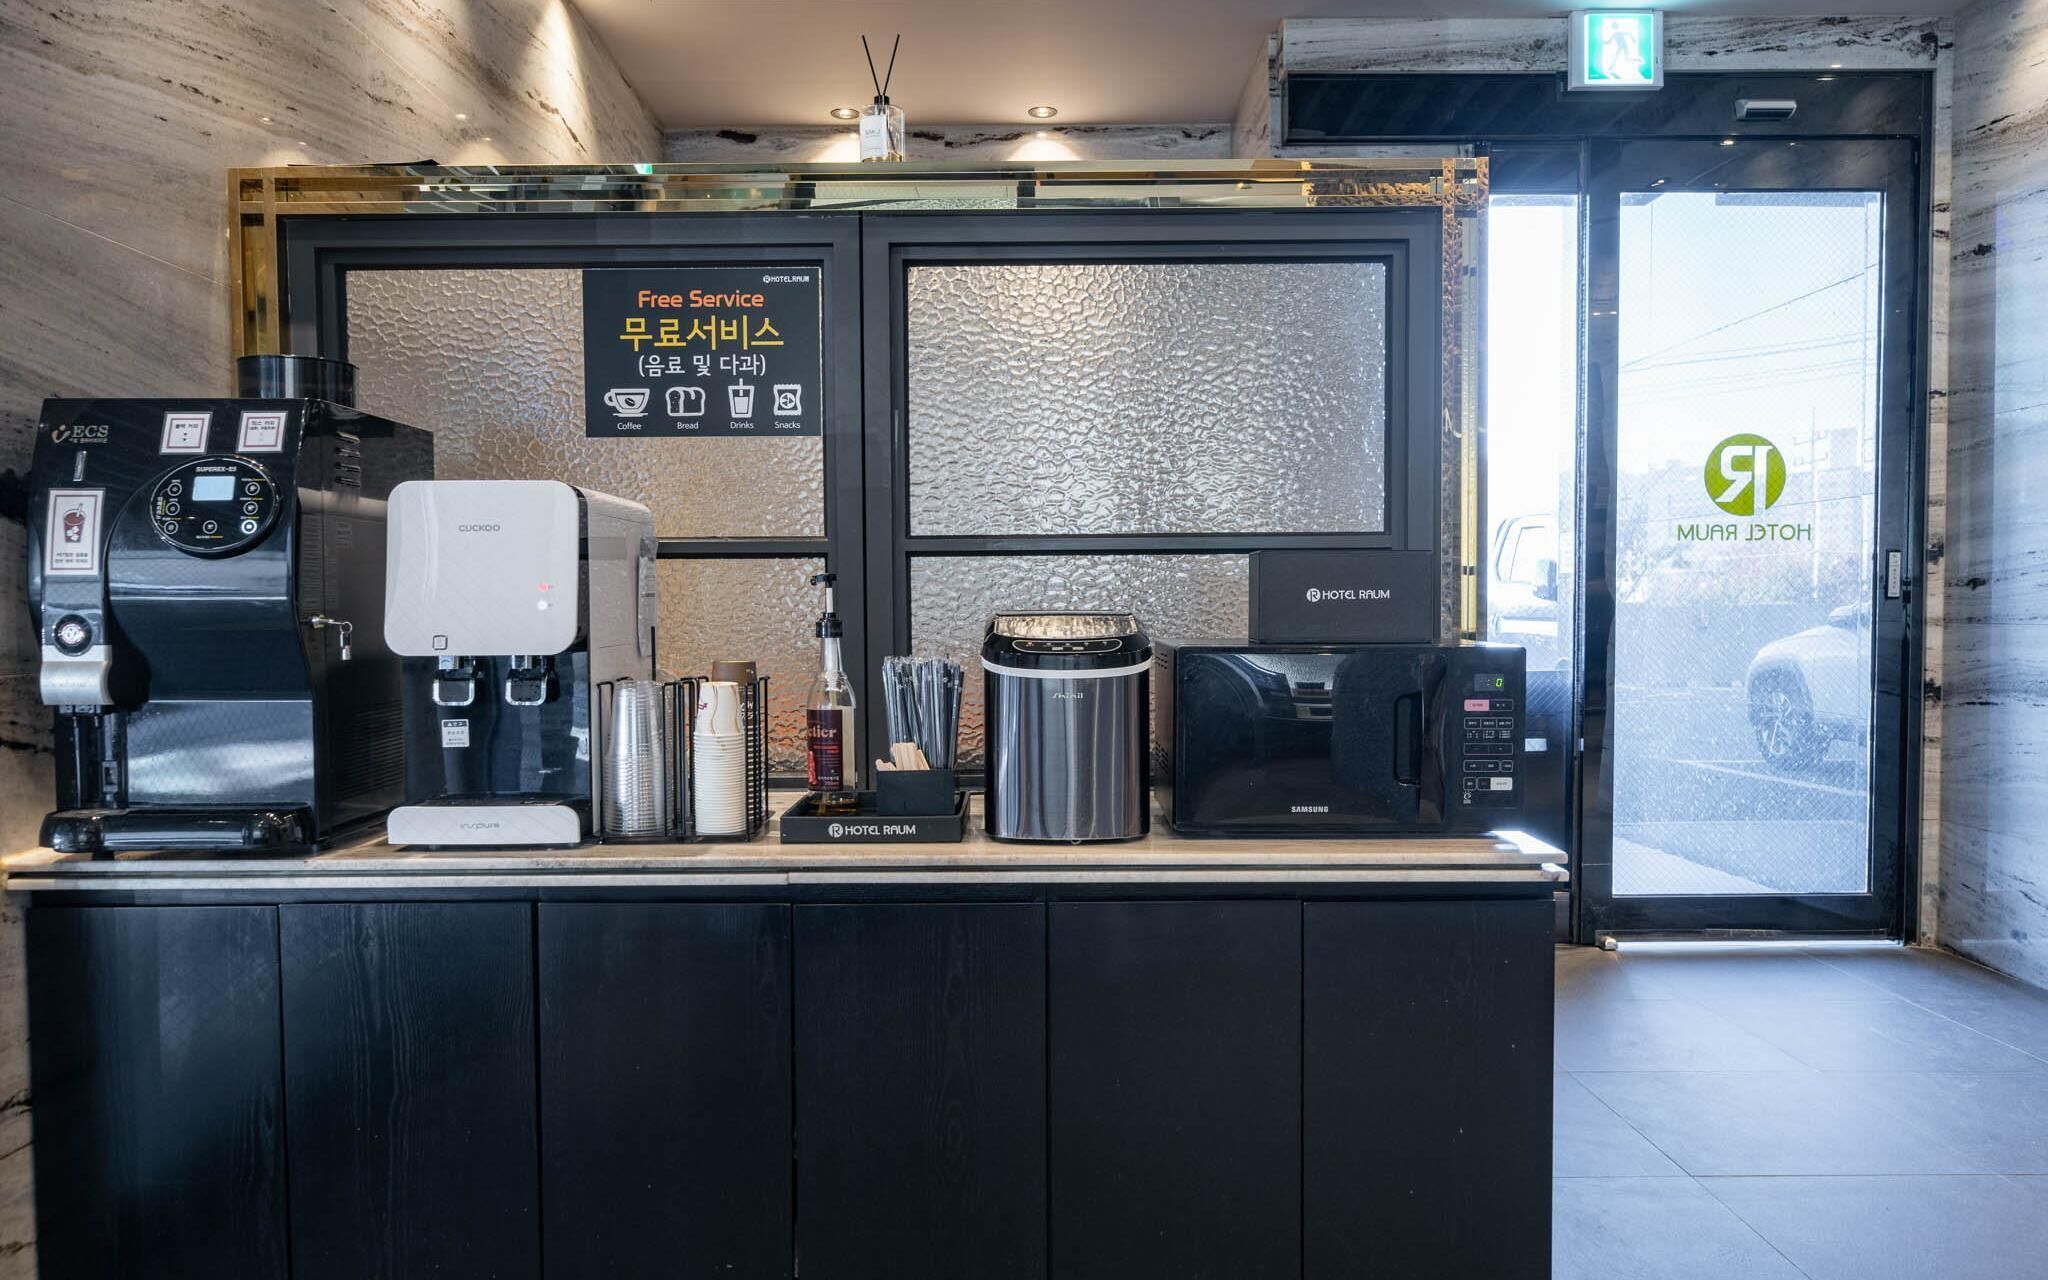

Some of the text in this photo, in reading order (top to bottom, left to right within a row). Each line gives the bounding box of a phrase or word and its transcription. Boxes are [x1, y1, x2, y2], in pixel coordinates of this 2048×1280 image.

[638, 290, 765, 308] Free Service
[619, 314, 785, 352] 무료서비스
[638, 353, 767, 377] (음료 및 다과)
[617, 421, 643, 431] Coffee
[676, 421, 699, 430] Bread
[730, 420, 755, 430] Drinks
[774, 420, 801, 430] Snacks
[71, 425, 109, 438] ECS
[458, 523, 501, 533] CUCKOO
[1321, 589, 1356, 601] HOTEL
[1359, 588, 1390, 600] RAUM
[1290, 805, 1329, 814] SAMSUNG
[844, 825, 880, 836] HOTEL
[883, 824, 916, 835] RAUM
